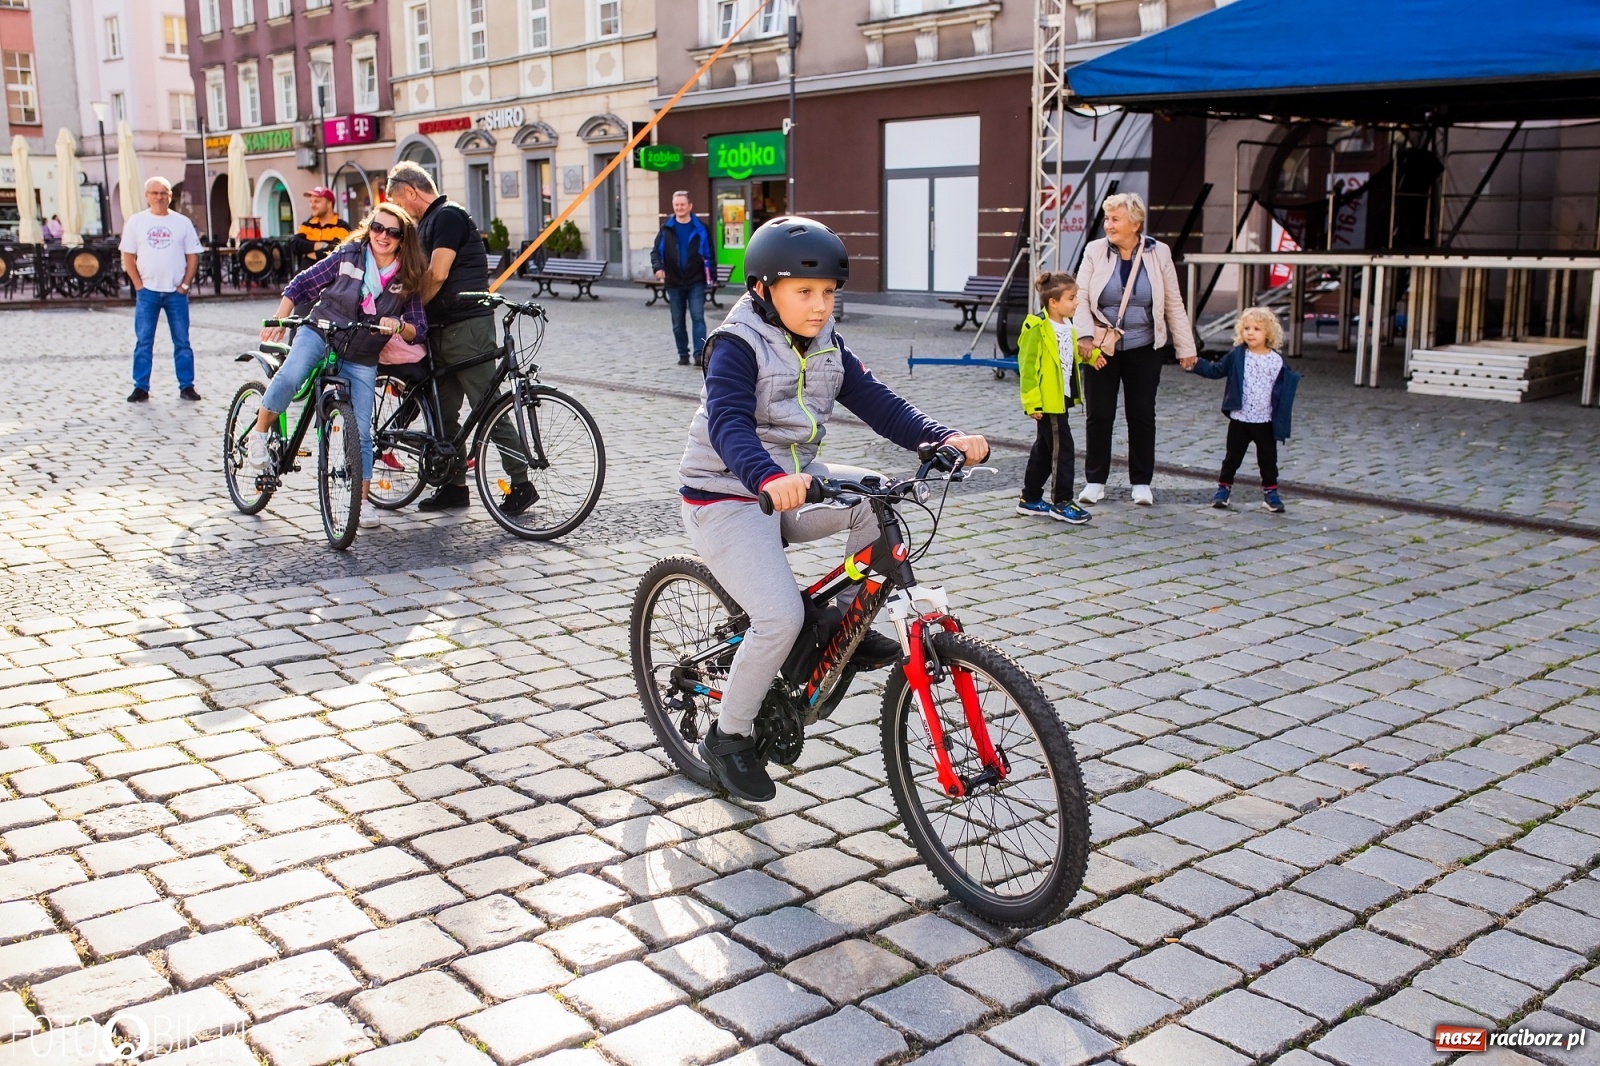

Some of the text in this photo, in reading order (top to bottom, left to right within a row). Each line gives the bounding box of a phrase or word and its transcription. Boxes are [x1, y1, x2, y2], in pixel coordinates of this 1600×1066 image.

[485, 106, 525, 130] SHIRO
[245, 130, 291, 152] KANTOR
[648, 150, 681, 163] żabka
[718, 142, 775, 169] żabka
